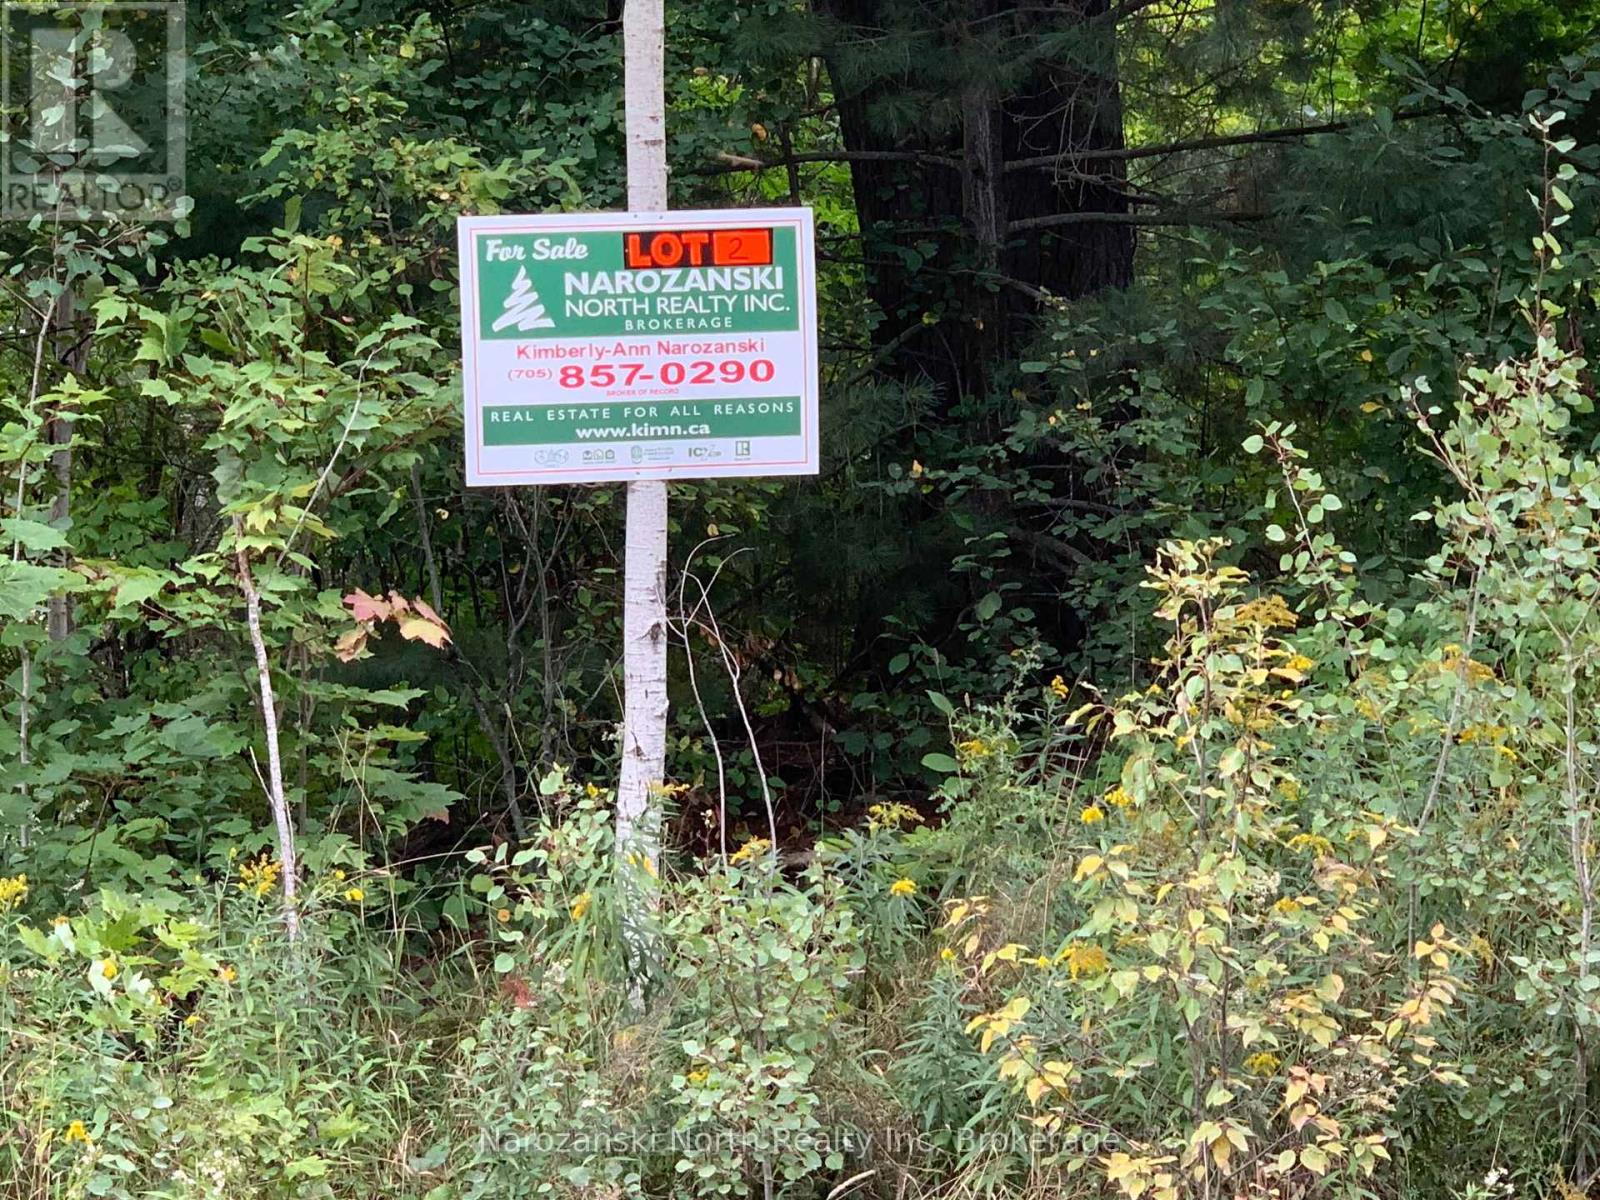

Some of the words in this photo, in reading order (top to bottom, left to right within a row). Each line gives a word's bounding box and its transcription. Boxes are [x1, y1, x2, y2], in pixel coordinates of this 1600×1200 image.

[486, 239, 526, 262] For
[532, 237, 589, 260] Sale
[628, 232, 709, 267] LOT
[728, 237, 749, 260] 2
[564, 267, 784, 295] NAROZANSKI
[565, 297, 649, 317] NORTH
[656, 295, 738, 315] REALTY
[744, 294, 791, 312] INC.
[625, 316, 733, 331] BROKERAGE
[516, 342, 651, 361] Kimberly-Ann
[657, 338, 765, 356] Narozanski
[508, 368, 553, 381] (705)
[559, 359, 776, 388] 857-0290
[490, 411, 534, 422] REAL
[547, 408, 611, 421] ESTATE
[623, 406, 658, 418] FOR
[670, 405, 702, 416] ALL
[714, 402, 795, 415] REASONS
[576, 423, 711, 438] www.kimn.ca
